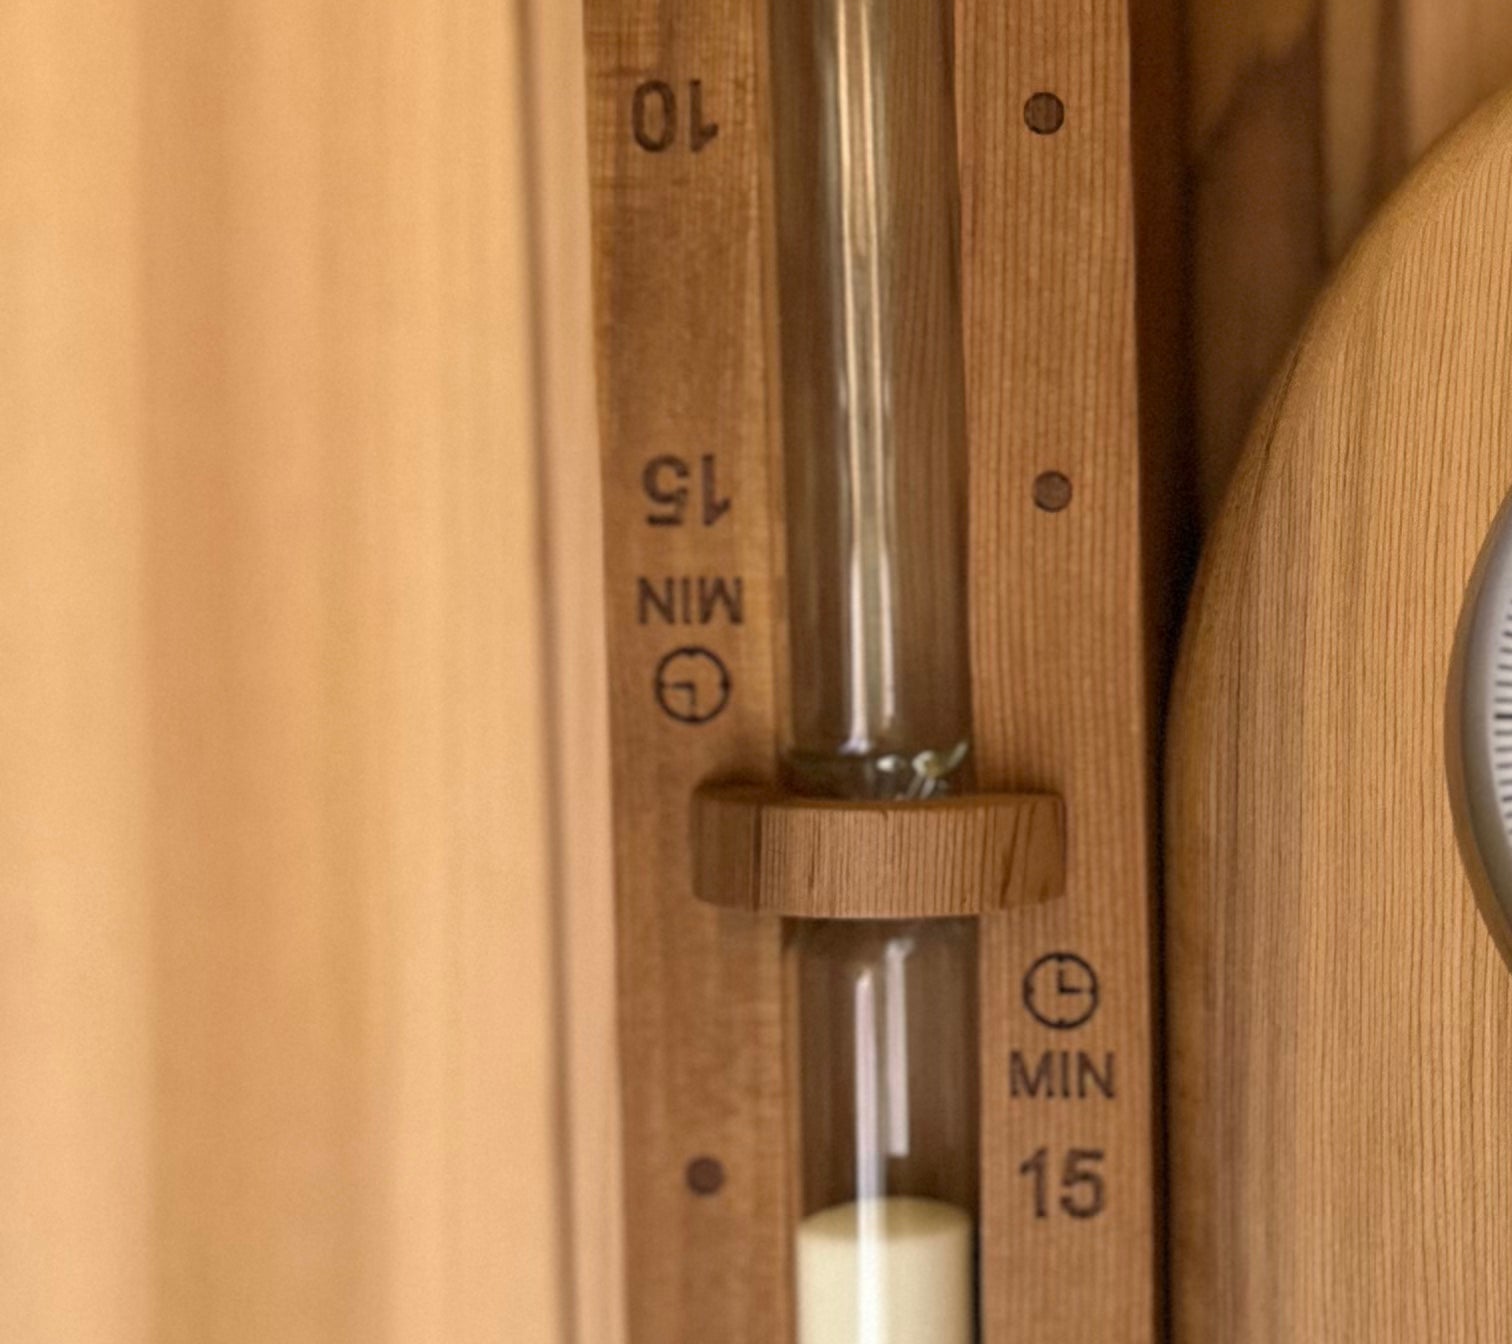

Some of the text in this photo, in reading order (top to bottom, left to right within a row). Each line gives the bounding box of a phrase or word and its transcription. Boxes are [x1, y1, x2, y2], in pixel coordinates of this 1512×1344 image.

[631, 78, 718, 154] 10
[642, 454, 731, 526] 15
[637, 576, 744, 626] MIN
[1009, 1051, 1116, 1098] MIN
[1019, 1149, 1107, 1219] 15
